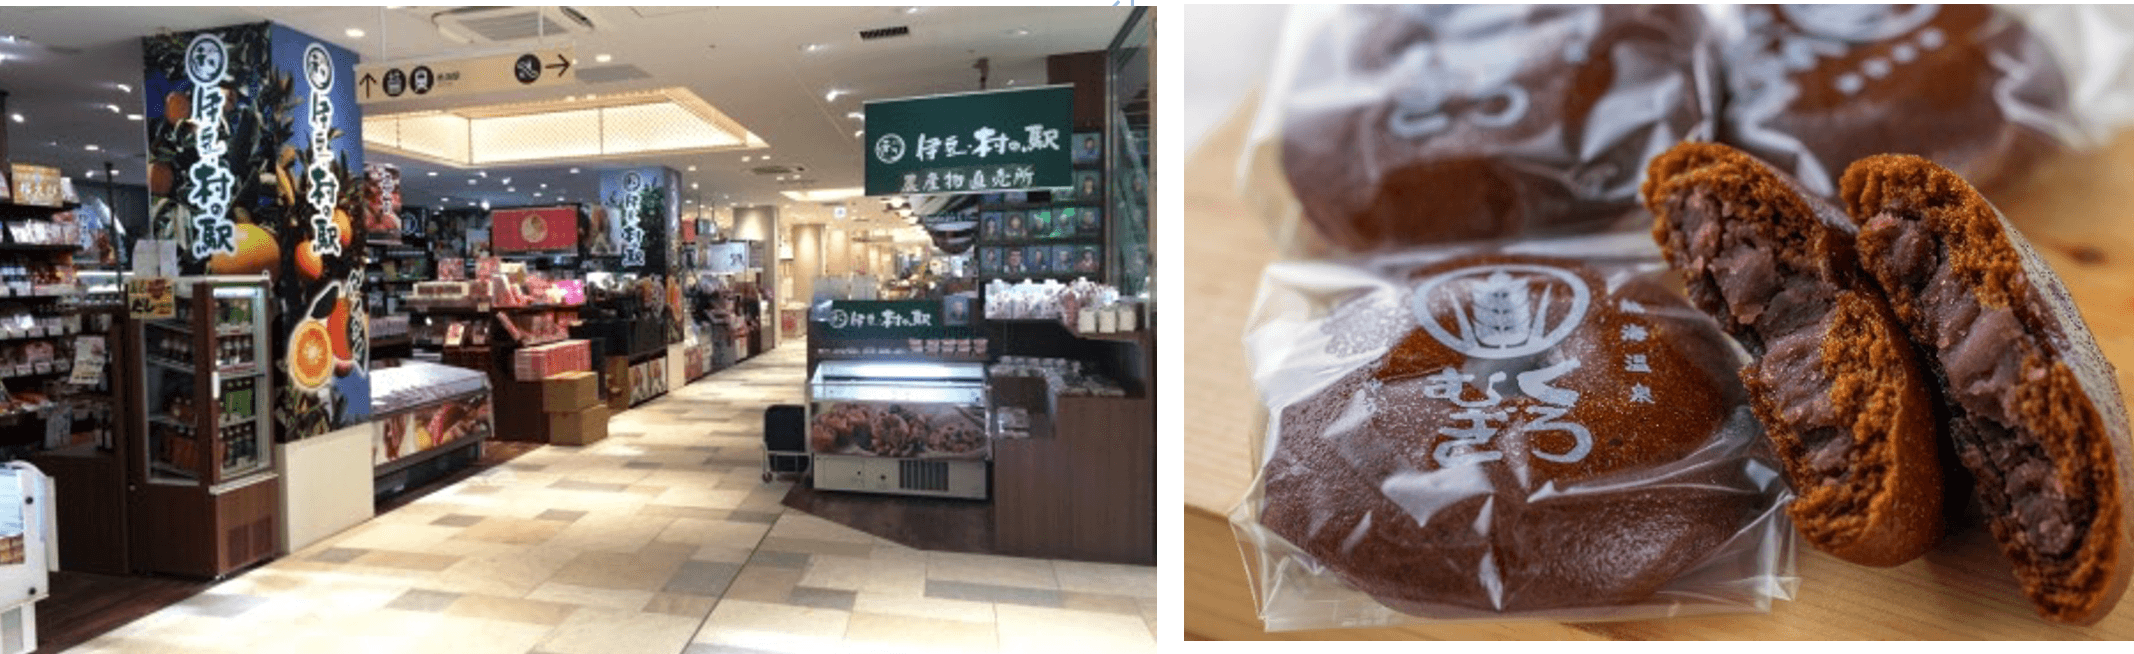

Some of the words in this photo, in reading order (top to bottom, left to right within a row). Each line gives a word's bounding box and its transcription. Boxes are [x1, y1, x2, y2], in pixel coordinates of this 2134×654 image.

[902, 164, 1035, 192] 農産物直売所
